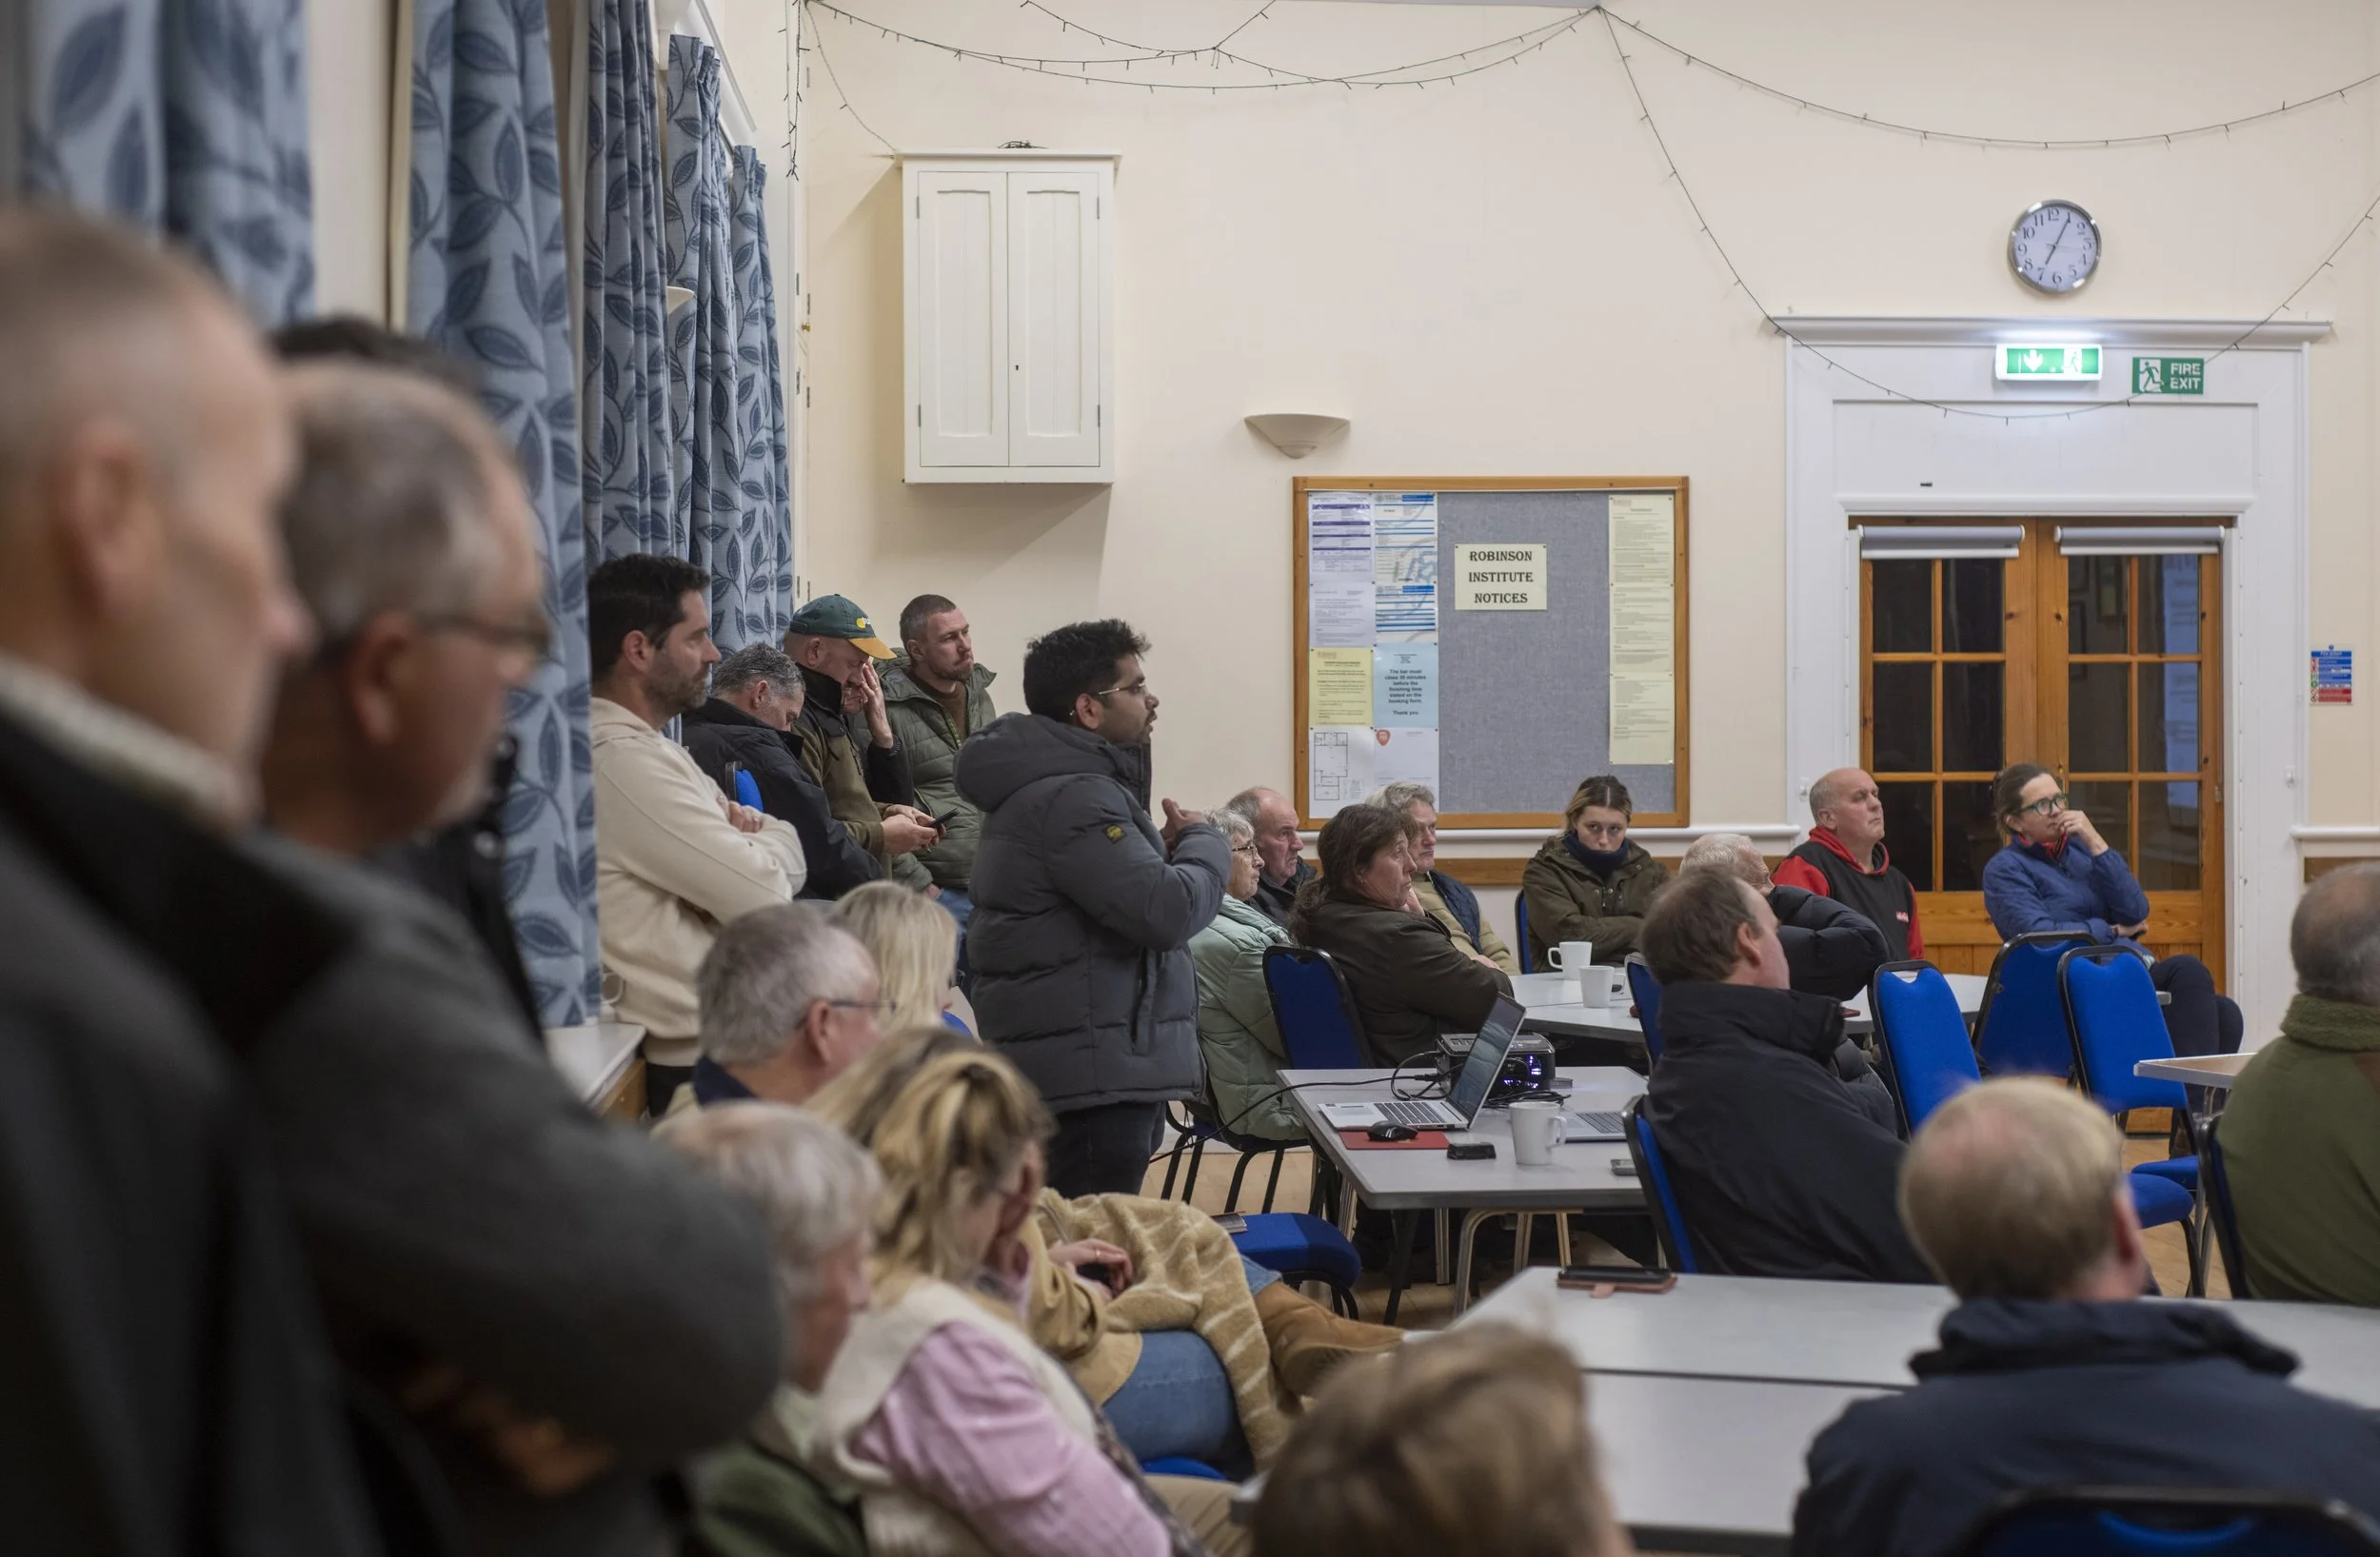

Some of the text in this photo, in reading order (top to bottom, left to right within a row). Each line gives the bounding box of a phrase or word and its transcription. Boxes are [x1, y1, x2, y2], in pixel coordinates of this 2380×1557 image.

[2033, 213, 2044, 227] 11
[2047, 208, 2059, 221] 12
[2023, 227, 2035, 240] 10
[2076, 222, 2086, 235] 2
[2017, 243, 2028, 255] 9
[2024, 258, 2033, 271] 8
[2037, 267, 2045, 281] 7
[2052, 271, 2062, 284] 6
[2171, 363, 2201, 375] FIRE
[2171, 377, 2201, 389] EXIT
[1469, 551, 1533, 562] ROBINSON
[1468, 571, 1534, 582] INSTITUTE
[1474, 593, 1528, 603] NOTICES
